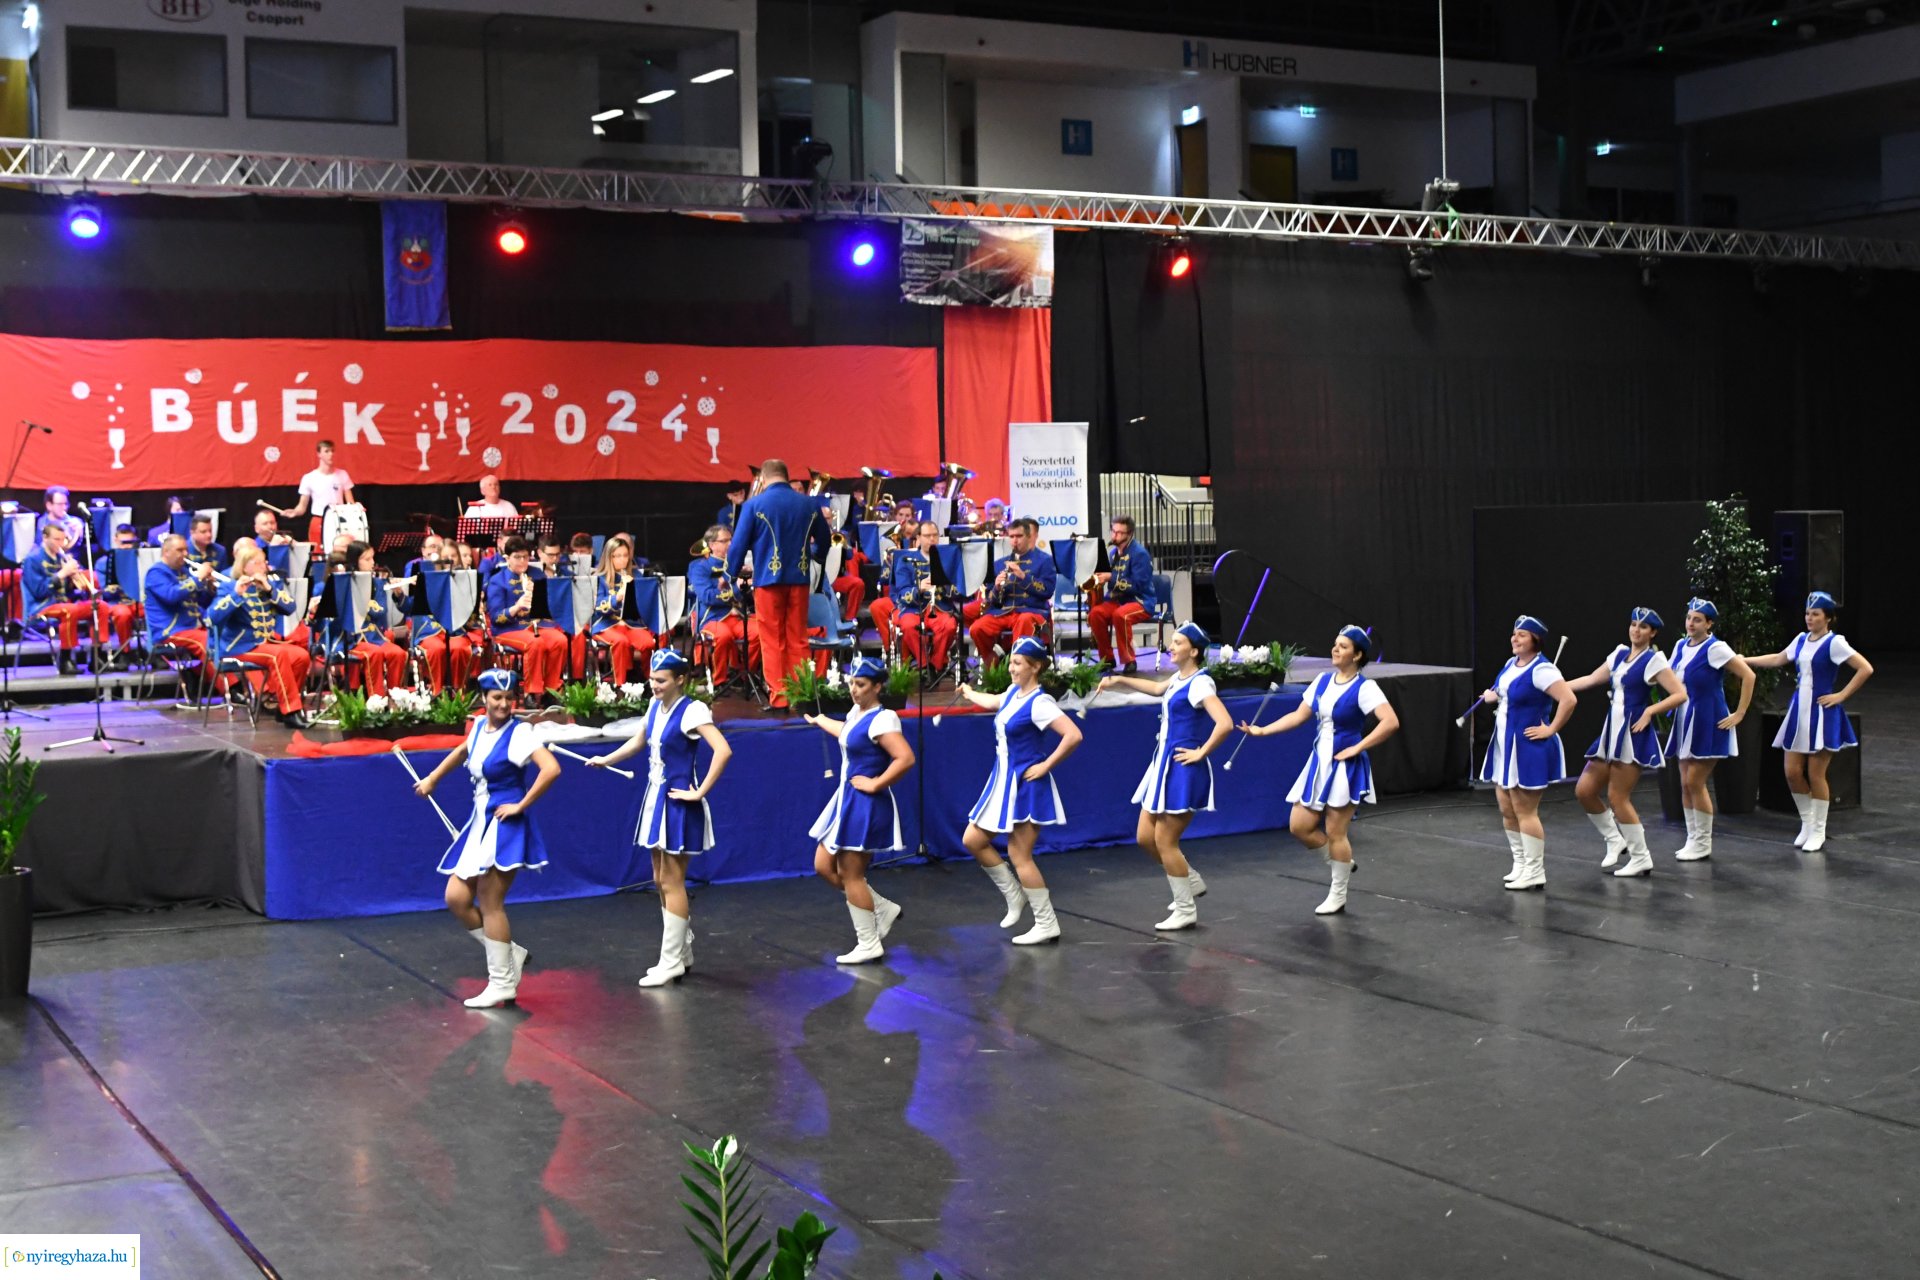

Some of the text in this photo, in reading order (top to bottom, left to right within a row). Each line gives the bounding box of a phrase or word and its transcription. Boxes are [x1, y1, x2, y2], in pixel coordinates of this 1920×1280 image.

[246, 11, 305, 26] Csoport
[151, 372, 688, 445] BÚÉK 2024
[1022, 456, 1075, 466] Szeretettel
[1022, 467, 1075, 478] köszöntjük
[1016, 478, 1082, 490] vendégeinket!
[1038, 516, 1078, 526] SALDO
